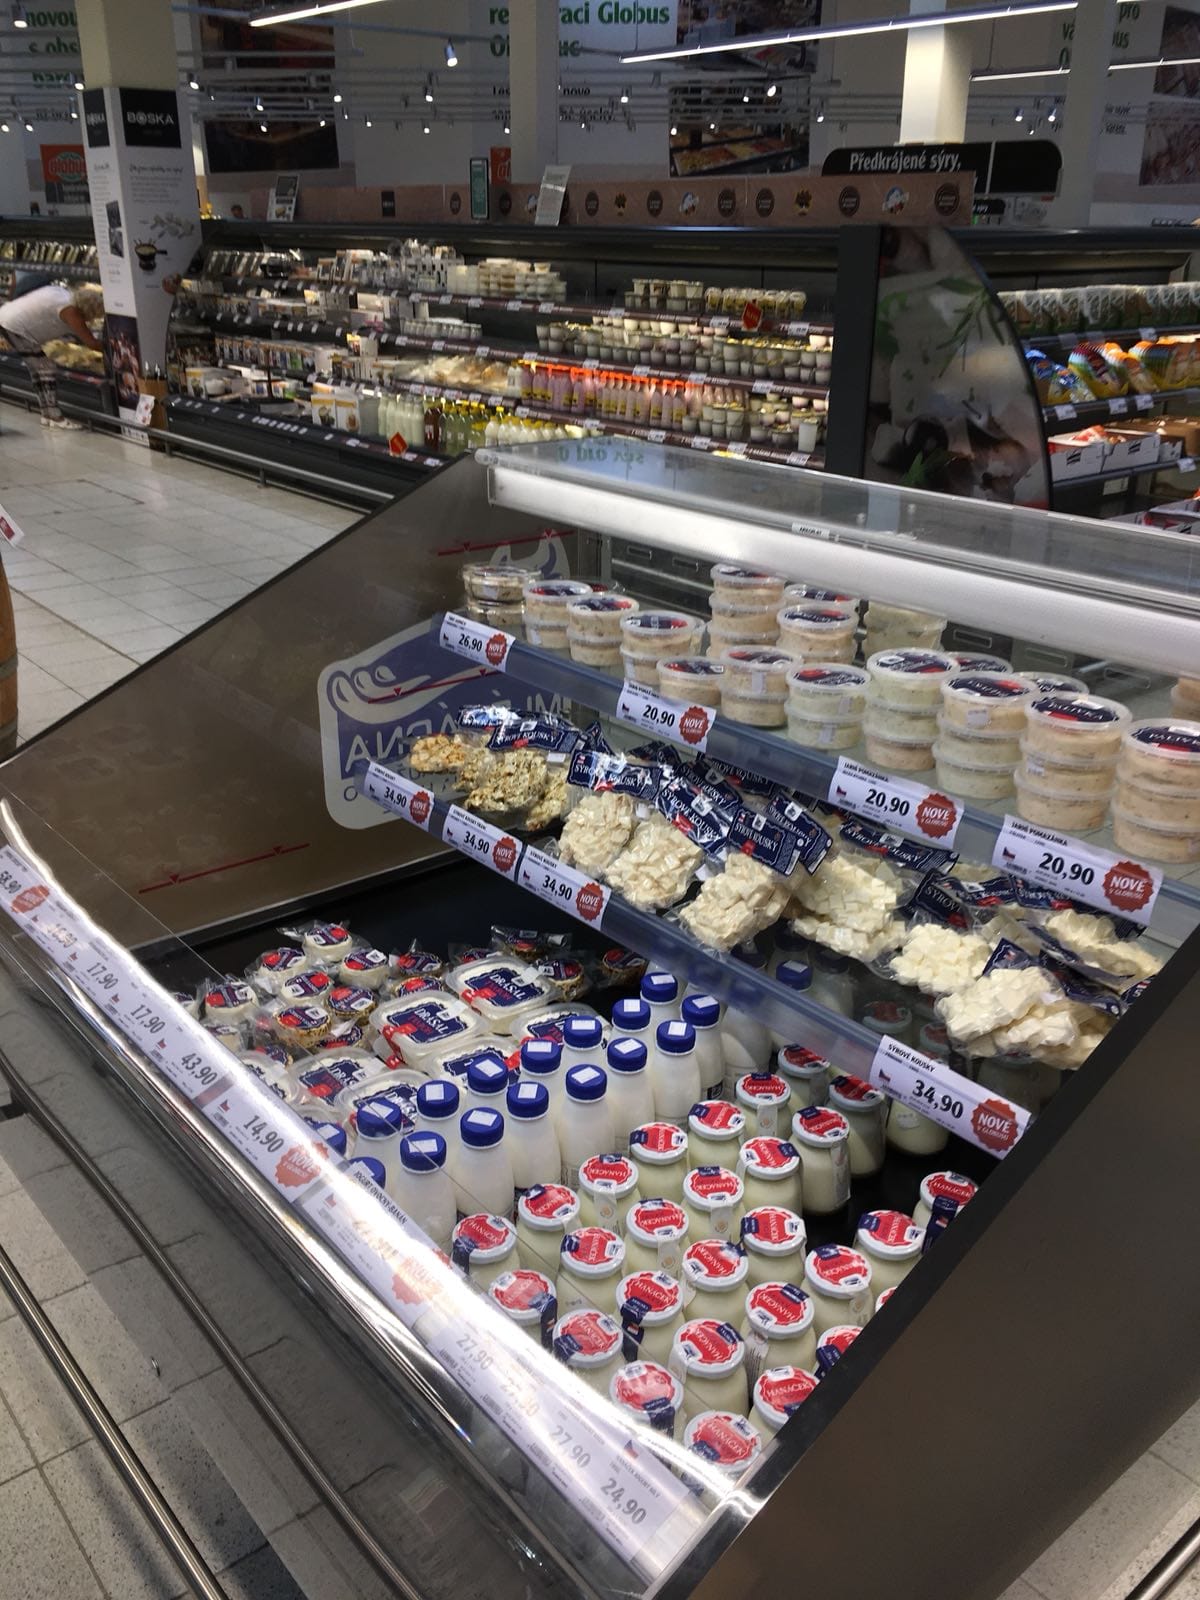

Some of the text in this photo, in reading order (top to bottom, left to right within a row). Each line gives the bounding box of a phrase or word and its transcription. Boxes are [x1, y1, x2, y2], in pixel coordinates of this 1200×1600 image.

[597, 1, 671, 25] Globus
[127, 112, 175, 126] BOSKA
[850, 149, 962, 174] Předkrájené sýry,
[458, 633, 483, 652] 26,90
[642, 704, 675, 727] 20,90
[383, 786, 407, 808] 34,90
[865, 788, 911, 817] 20,90
[463, 830, 490, 854] 34,90
[1038, 852, 1096, 886] 20,90
[542, 874, 573, 901] 34,90
[86, 961, 119, 990] 17,90
[130, 1003, 166, 1034] 17,90
[180, 1052, 219, 1086] 43,90
[910, 1056, 937, 1073] KOUSKY
[912, 1079, 964, 1119] 34,90
[243, 1115, 285, 1153] 14,90
[456, 1333, 494, 1371] 27,90
[550, 1424, 592, 1469] 27,90
[600, 1477, 647, 1525] 24,90
